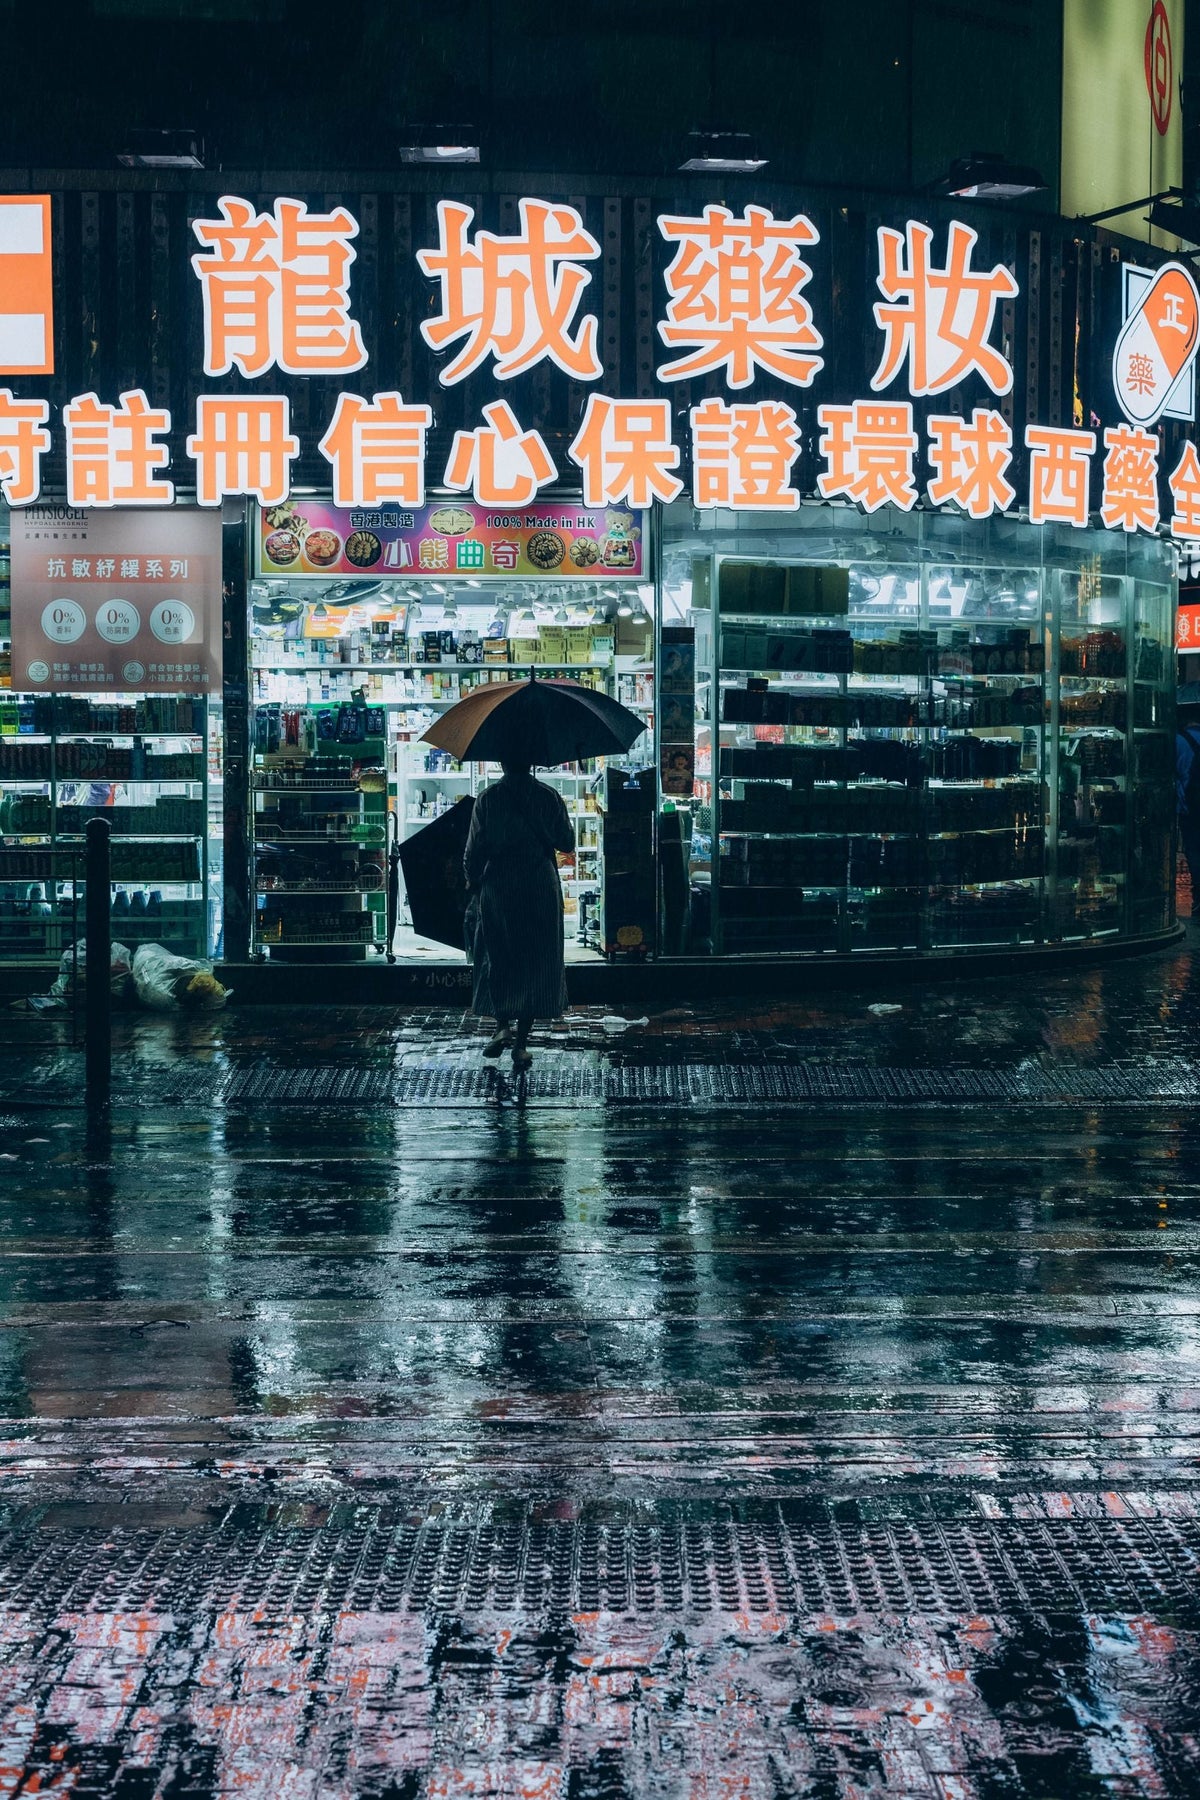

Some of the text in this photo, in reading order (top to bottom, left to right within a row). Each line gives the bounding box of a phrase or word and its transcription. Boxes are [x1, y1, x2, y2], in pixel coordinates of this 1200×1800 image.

[191, 194, 1020, 398] 龍城藥妝
[1158, 292, 1188, 335] 正
[1126, 352, 1157, 397] 藥
[25, 505, 88, 520] PHYSIOGEL
[349, 512, 415, 529] 香港製造
[486, 514, 522, 529] 100%
[525, 514, 558, 529] Made
[560, 515, 573, 529] in
[576, 515, 596, 528] HK
[383, 538, 521, 570] 小熊曲奇
[47, 558, 189, 578] 抗敏紓緩系列
[52, 608, 75, 624] 0%
[107, 608, 130, 624] 0%
[161, 609, 184, 625] 0%
[56, 626, 72, 635] 香料
[106, 626, 130, 635] 防腐劑
[164, 626, 180, 635] 色素
